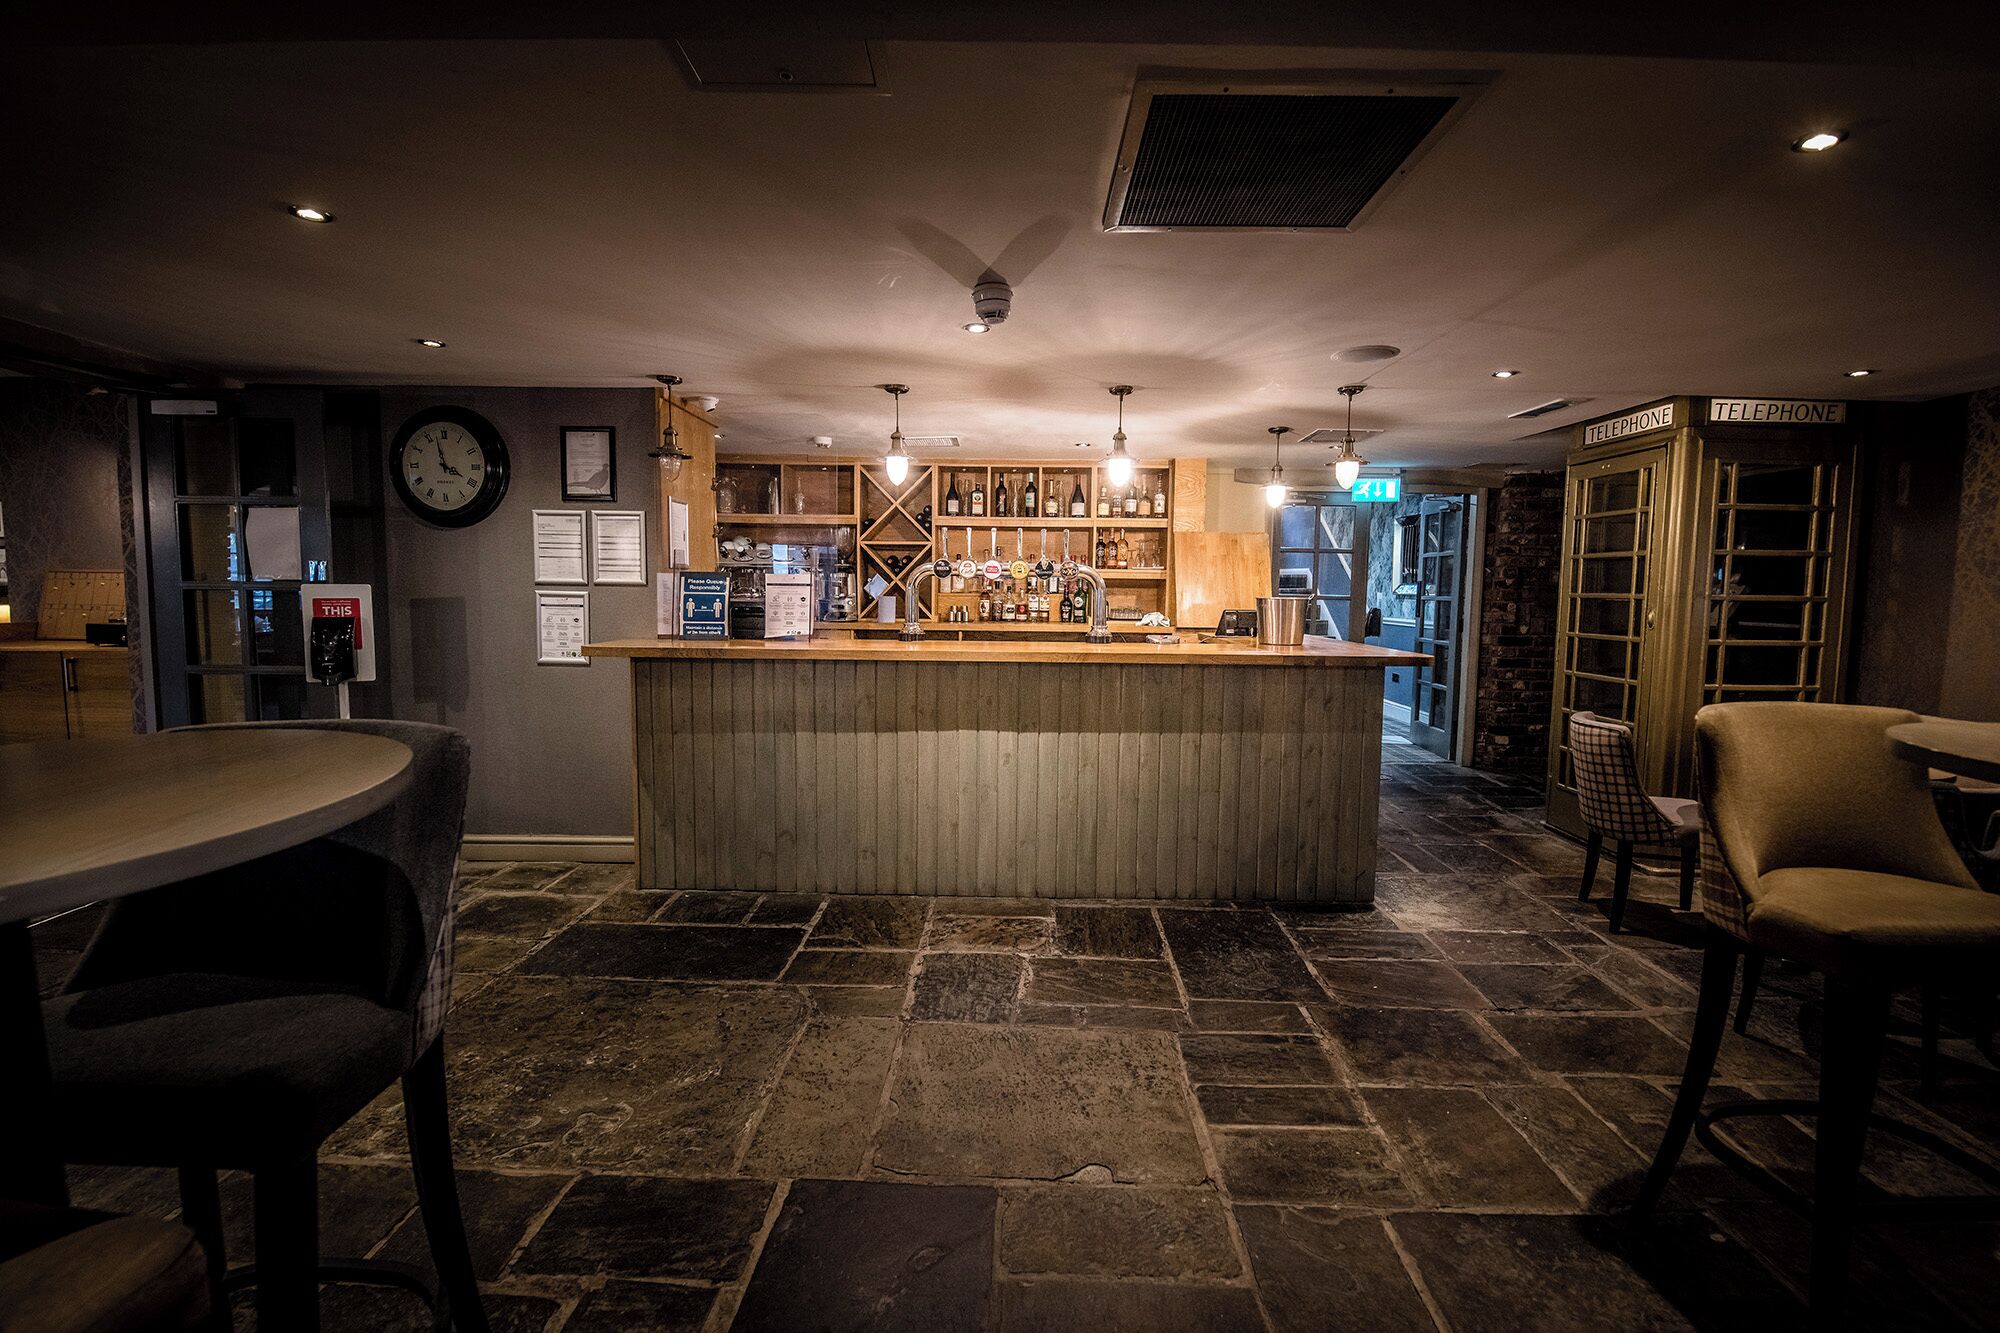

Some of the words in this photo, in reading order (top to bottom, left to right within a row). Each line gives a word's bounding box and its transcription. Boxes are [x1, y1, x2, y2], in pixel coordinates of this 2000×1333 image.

[1716, 402, 1839, 422] TELEPHONE
[1589, 407, 1671, 446] TELEPHONE
[322, 606, 352, 617] THIS
